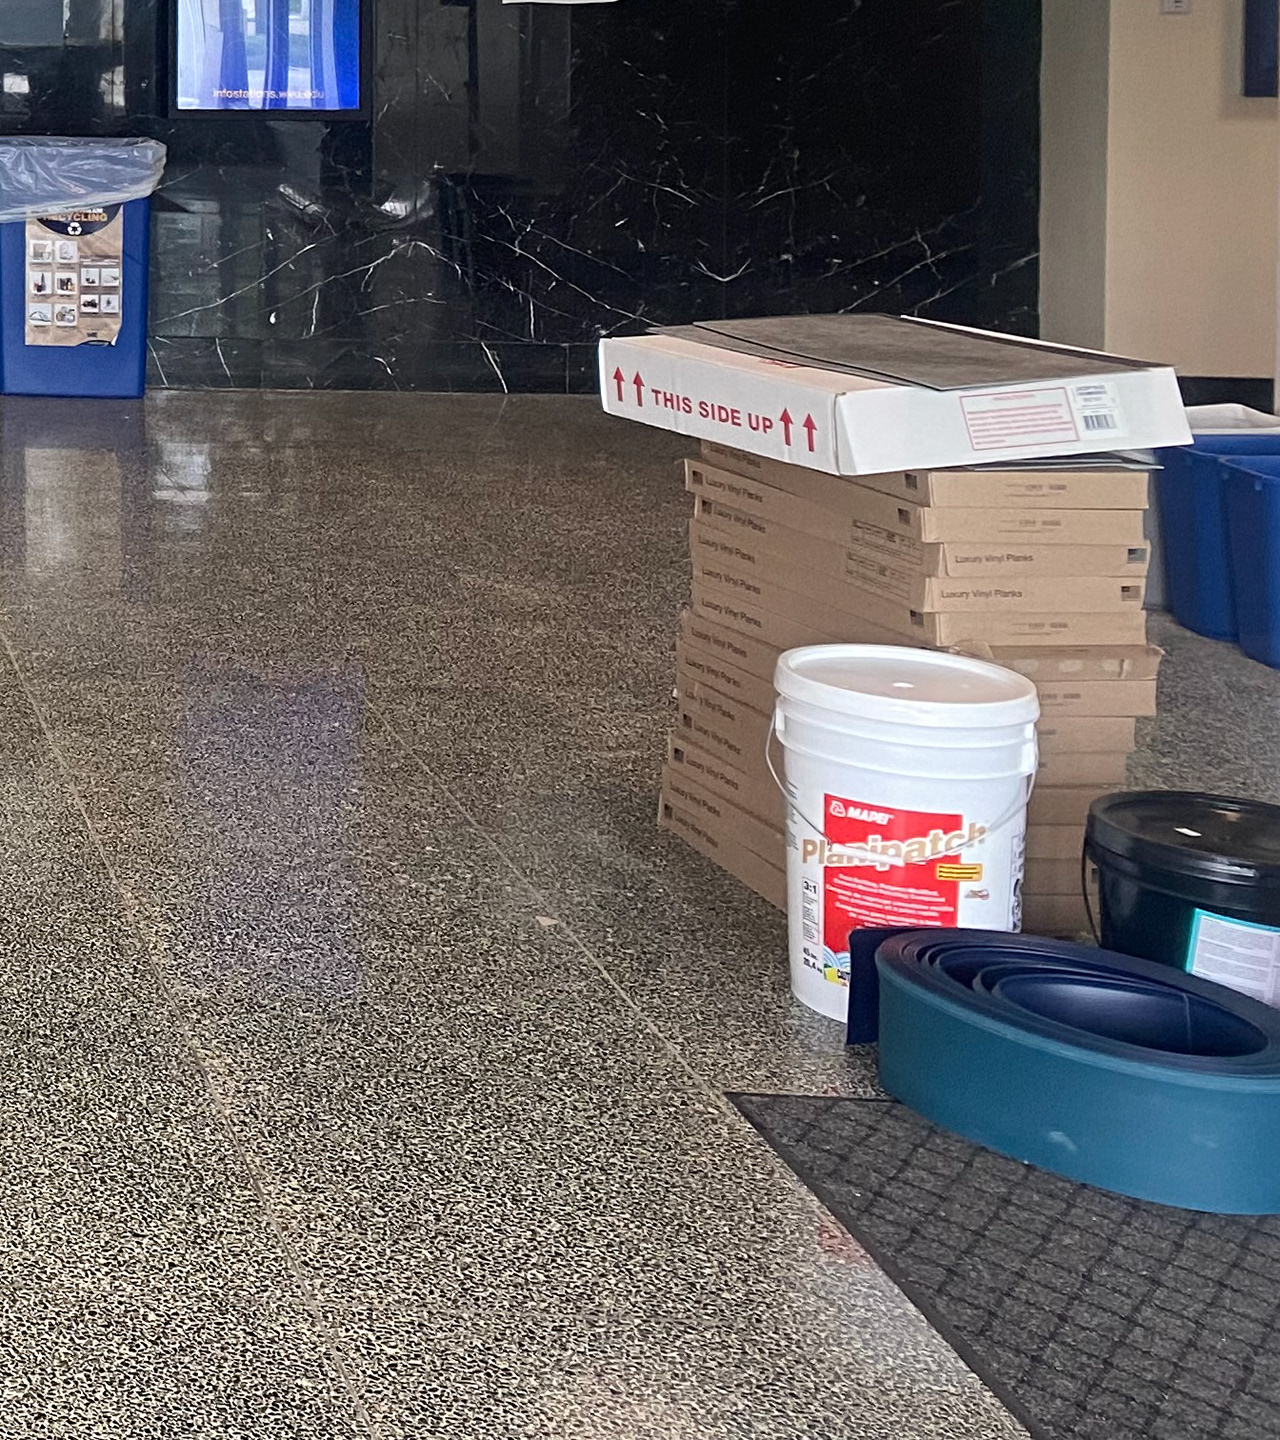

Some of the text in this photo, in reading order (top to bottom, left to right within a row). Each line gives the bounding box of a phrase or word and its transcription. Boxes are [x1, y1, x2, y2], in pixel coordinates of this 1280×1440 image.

[651, 388, 774, 434] THIS SIDE UP
[942, 589, 1023, 600] Luxury Vinyl Planks
[847, 806, 889, 825] MAPEI
[803, 881, 817, 894] 3:1
